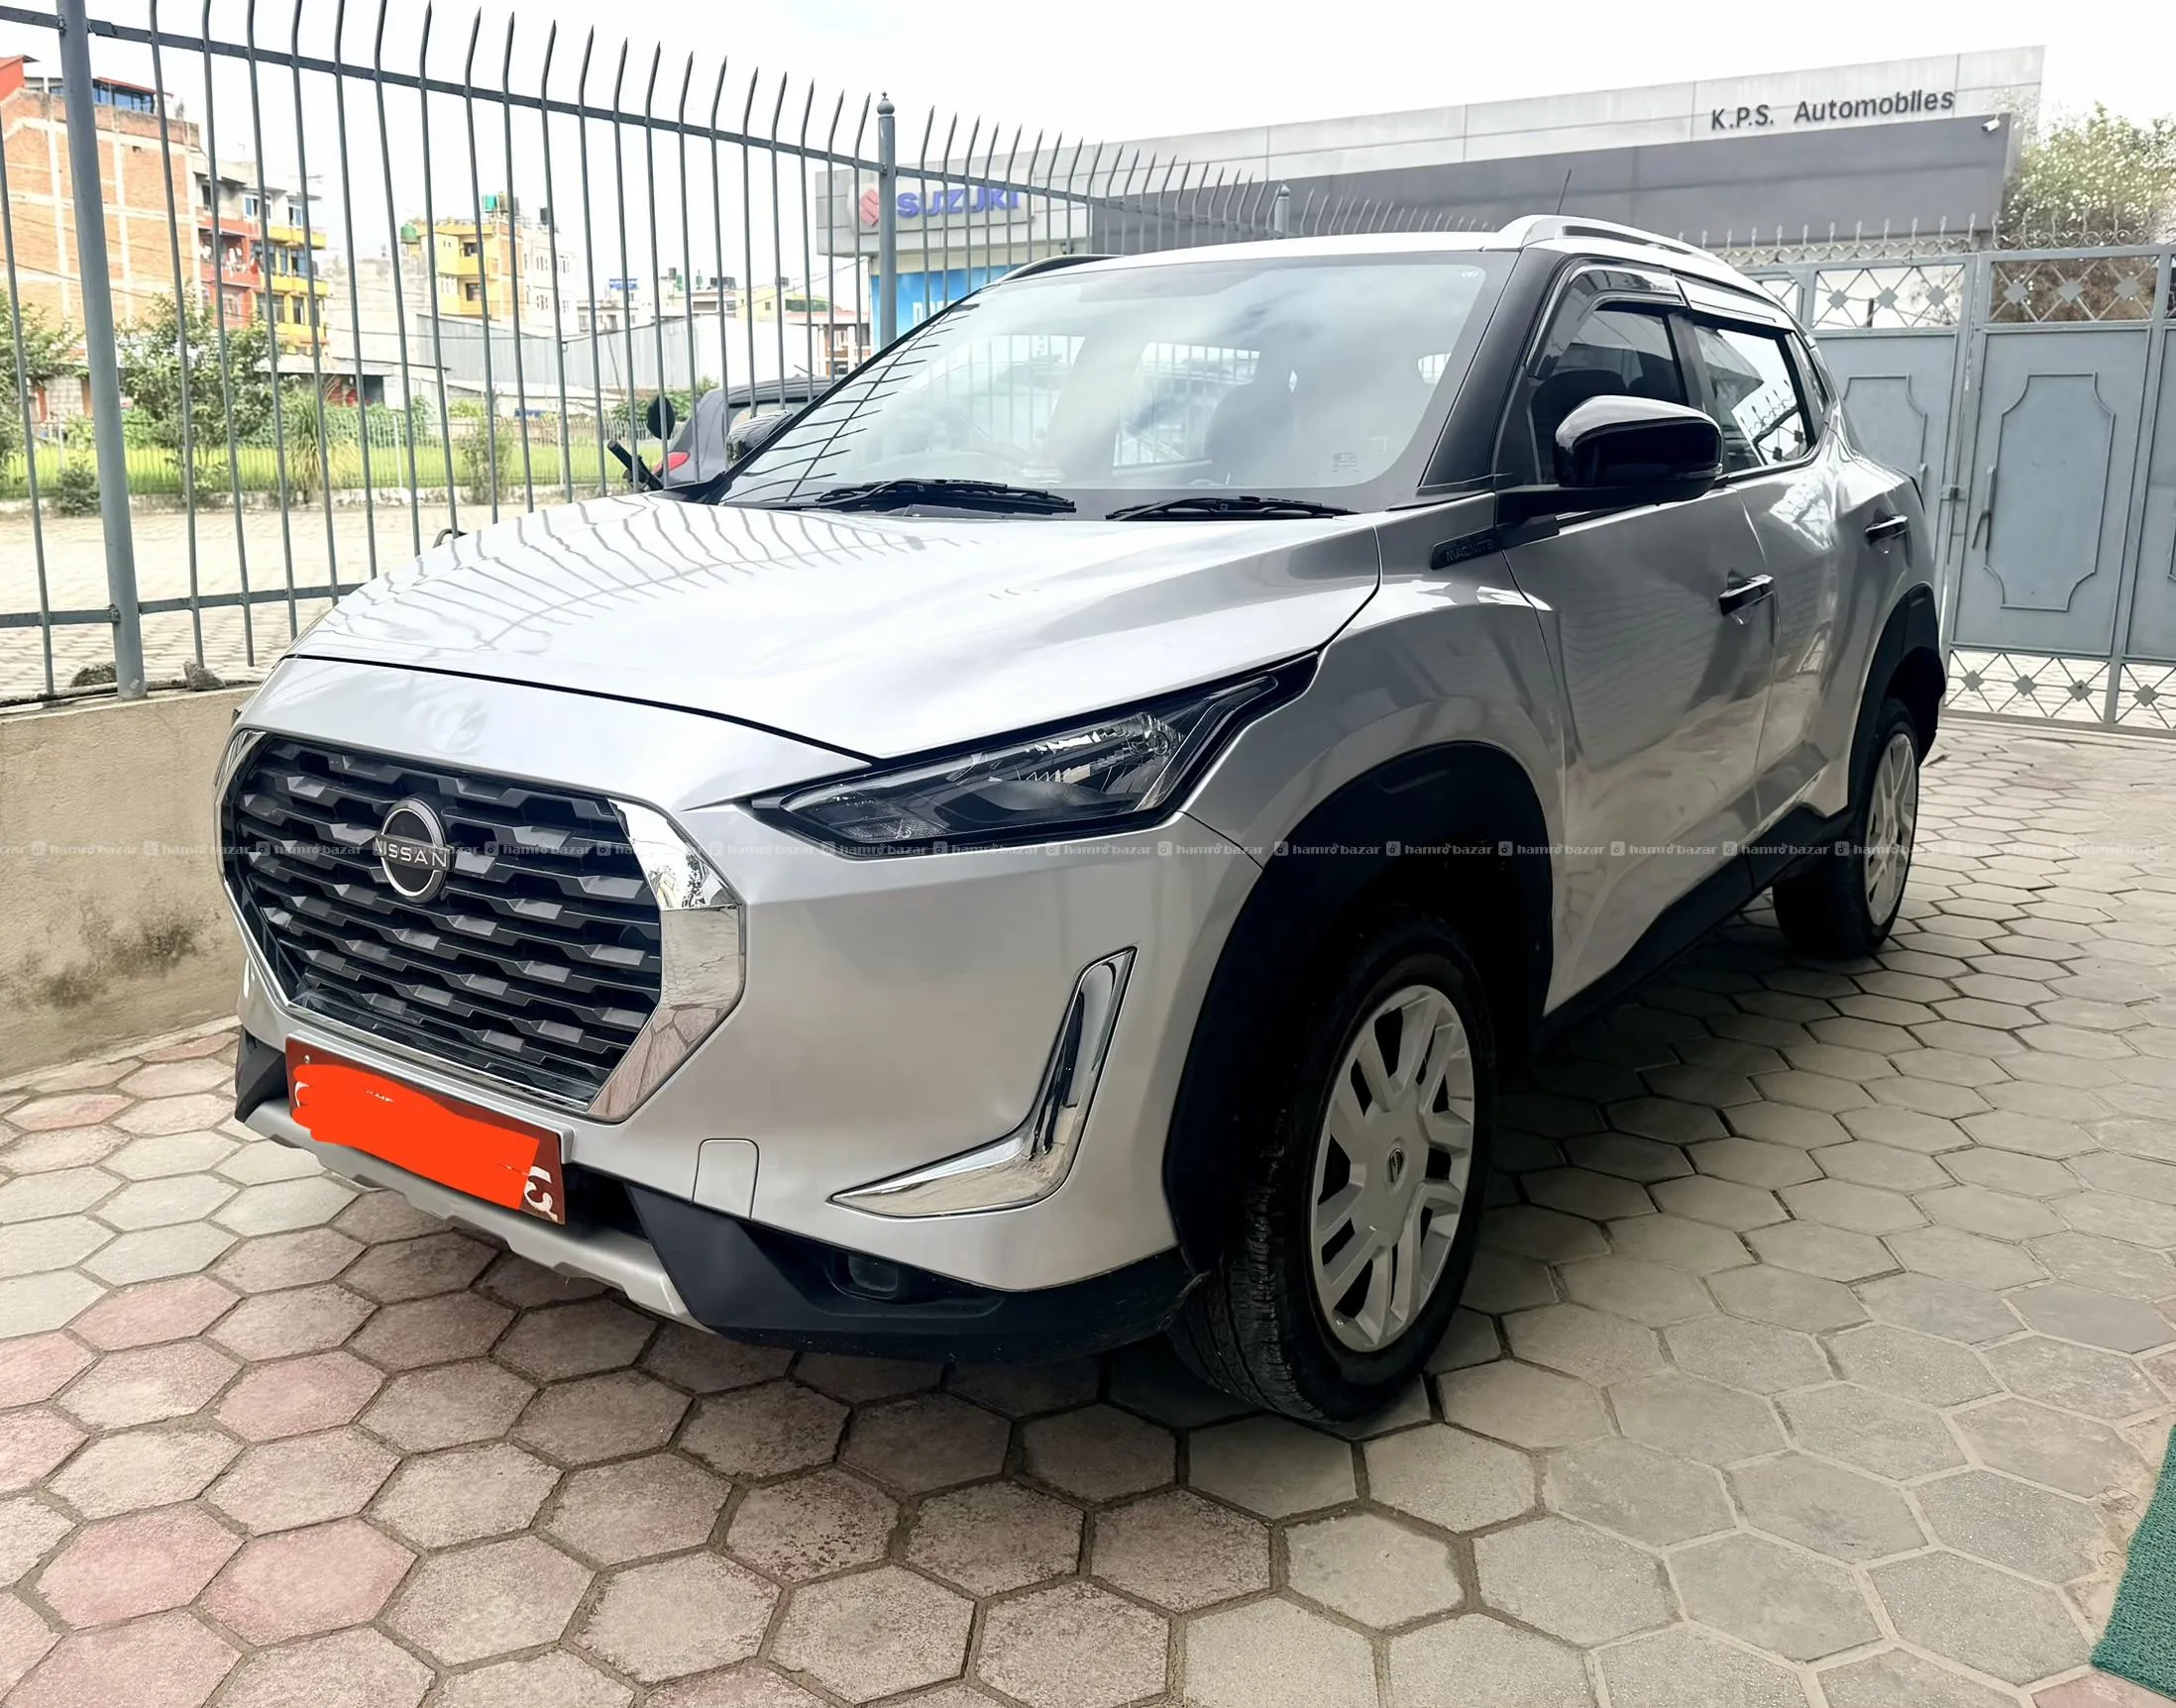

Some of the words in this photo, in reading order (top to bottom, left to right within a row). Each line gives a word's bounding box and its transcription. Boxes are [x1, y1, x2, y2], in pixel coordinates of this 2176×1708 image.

[1711, 105, 1774, 130] K.P.S.
[898, 186, 1020, 219] SUZUKI
[376, 838, 447, 868] NISSAN
